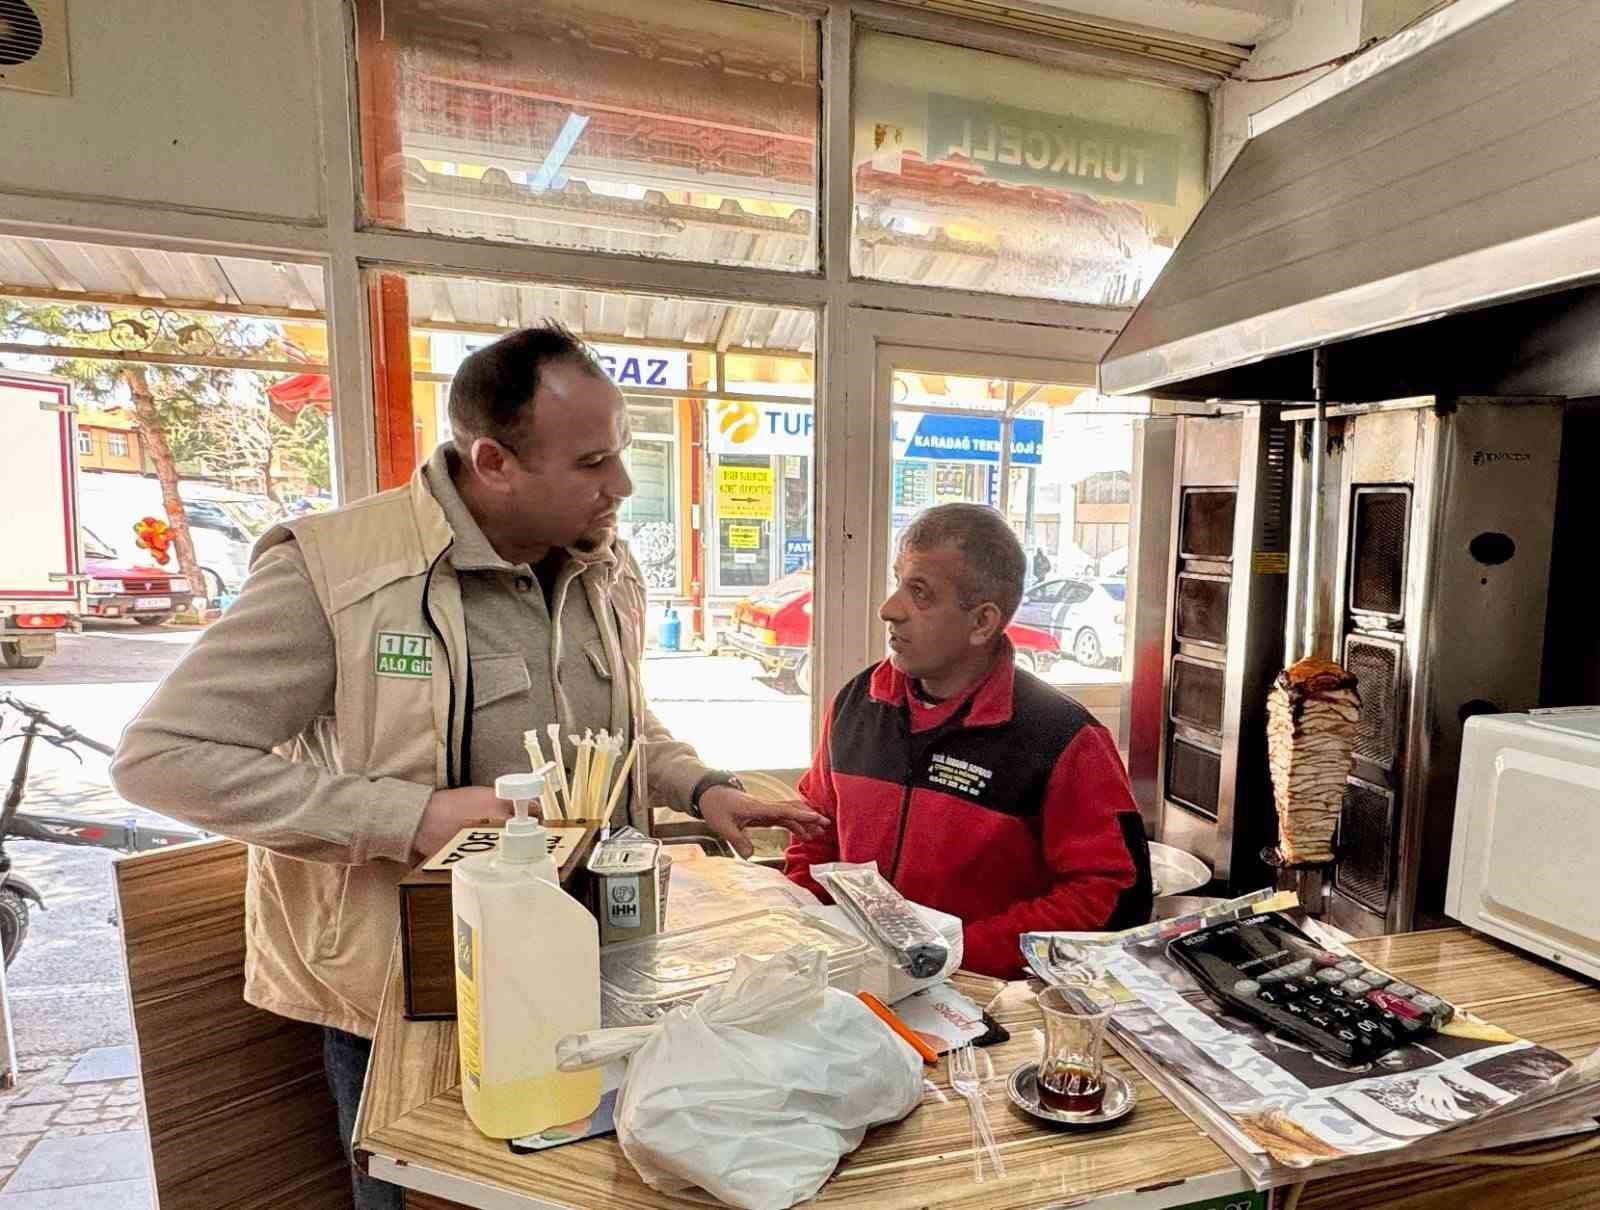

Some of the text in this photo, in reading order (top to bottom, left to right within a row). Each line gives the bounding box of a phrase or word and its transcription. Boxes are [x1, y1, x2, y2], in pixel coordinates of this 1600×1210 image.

[1261, 991, 1274, 1000] 7
[1284, 983, 1298, 992] 8
[1309, 995, 1322, 1004] 5
[1330, 987, 1343, 996] 6
[1334, 1008, 1350, 1017] 2
[1340, 1019, 1378, 1040] 0 00
